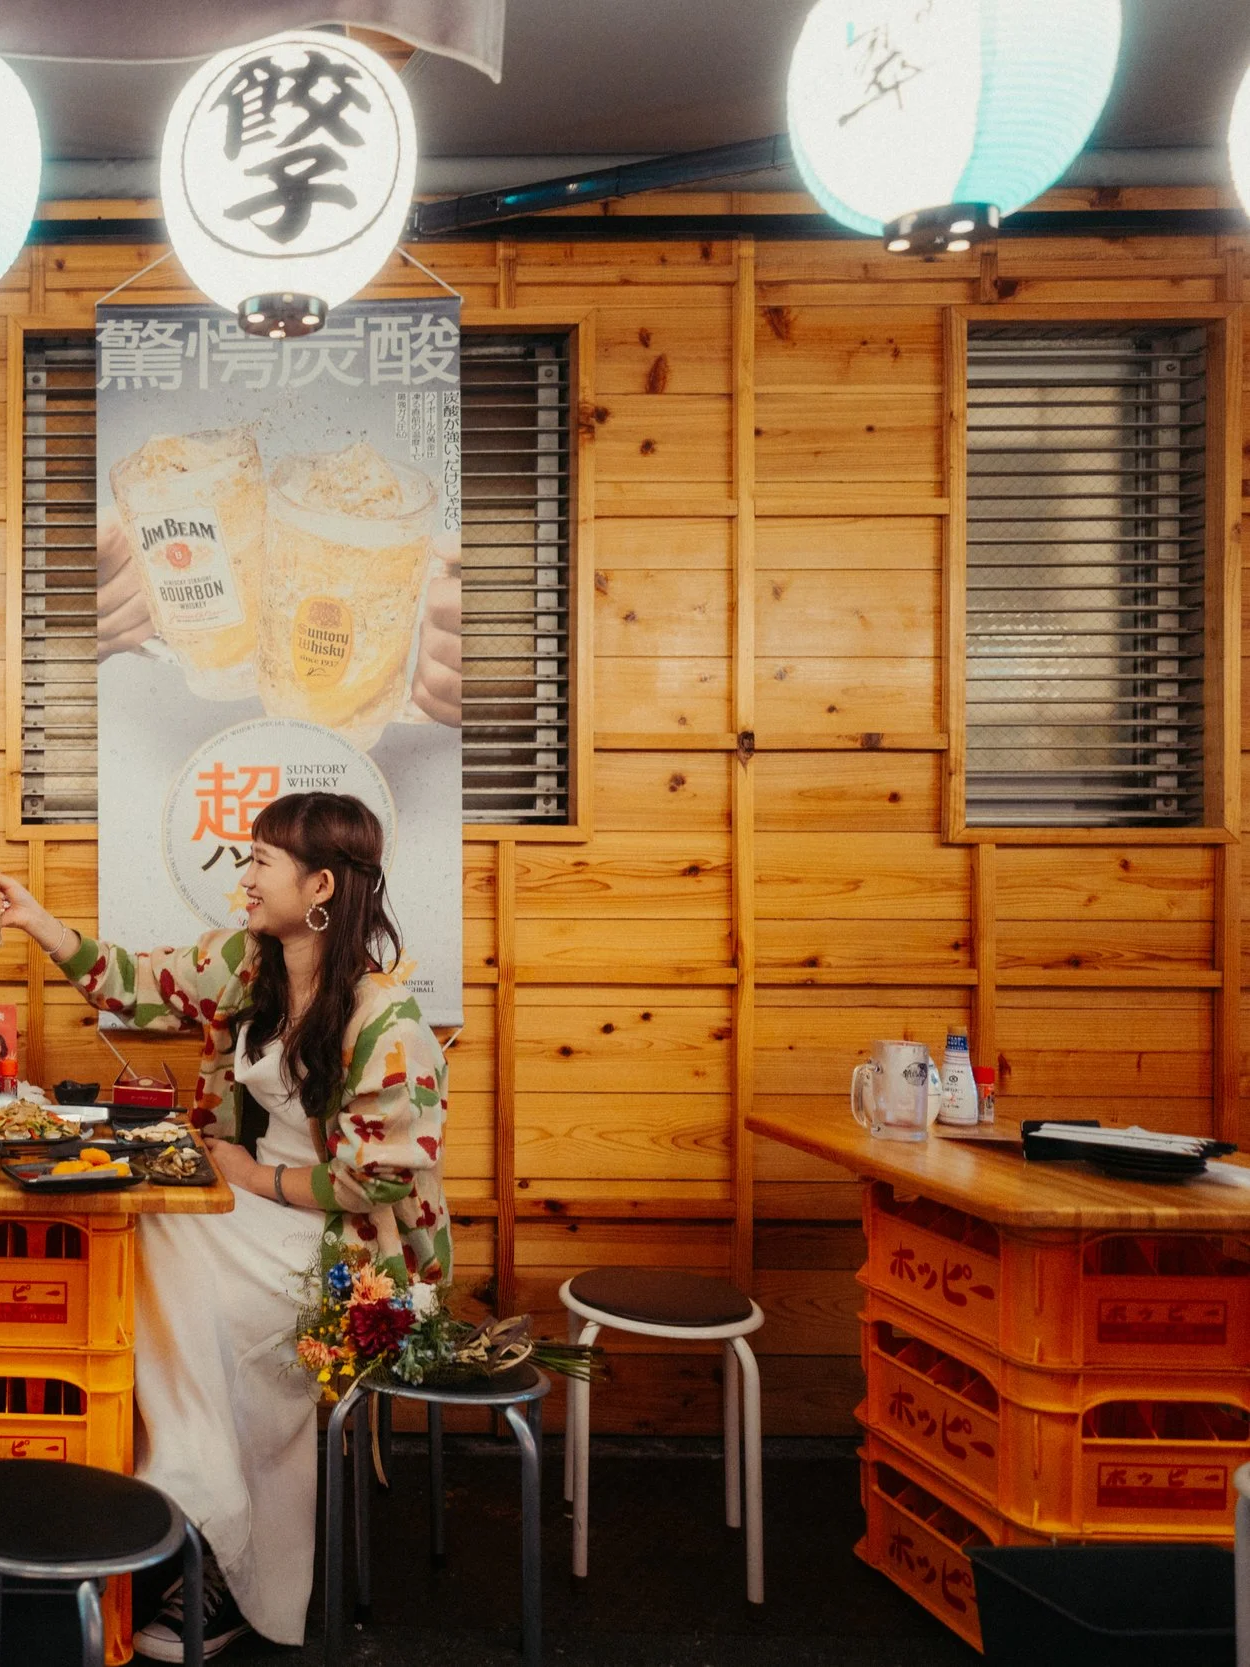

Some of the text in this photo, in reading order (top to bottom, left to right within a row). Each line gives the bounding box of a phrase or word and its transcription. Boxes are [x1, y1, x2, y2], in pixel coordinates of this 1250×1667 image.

[210, 49, 373, 246] 餃子
[96, 313, 461, 390] 驚愕炭酸
[163, 518, 217, 542] BEAM
[159, 580, 225, 602] BOURBON
[297, 623, 350, 645] Suntory
[298, 637, 345, 659] Whisky
[286, 764, 348, 775] SUNTORY
[286, 777, 339, 788] WHISKY
[191, 762, 280, 842] 超
[889, 1241, 995, 1307] ホッピー
[889, 1384, 995, 1460] ホッピー
[1104, 1470, 1221, 1487] ホッピー
